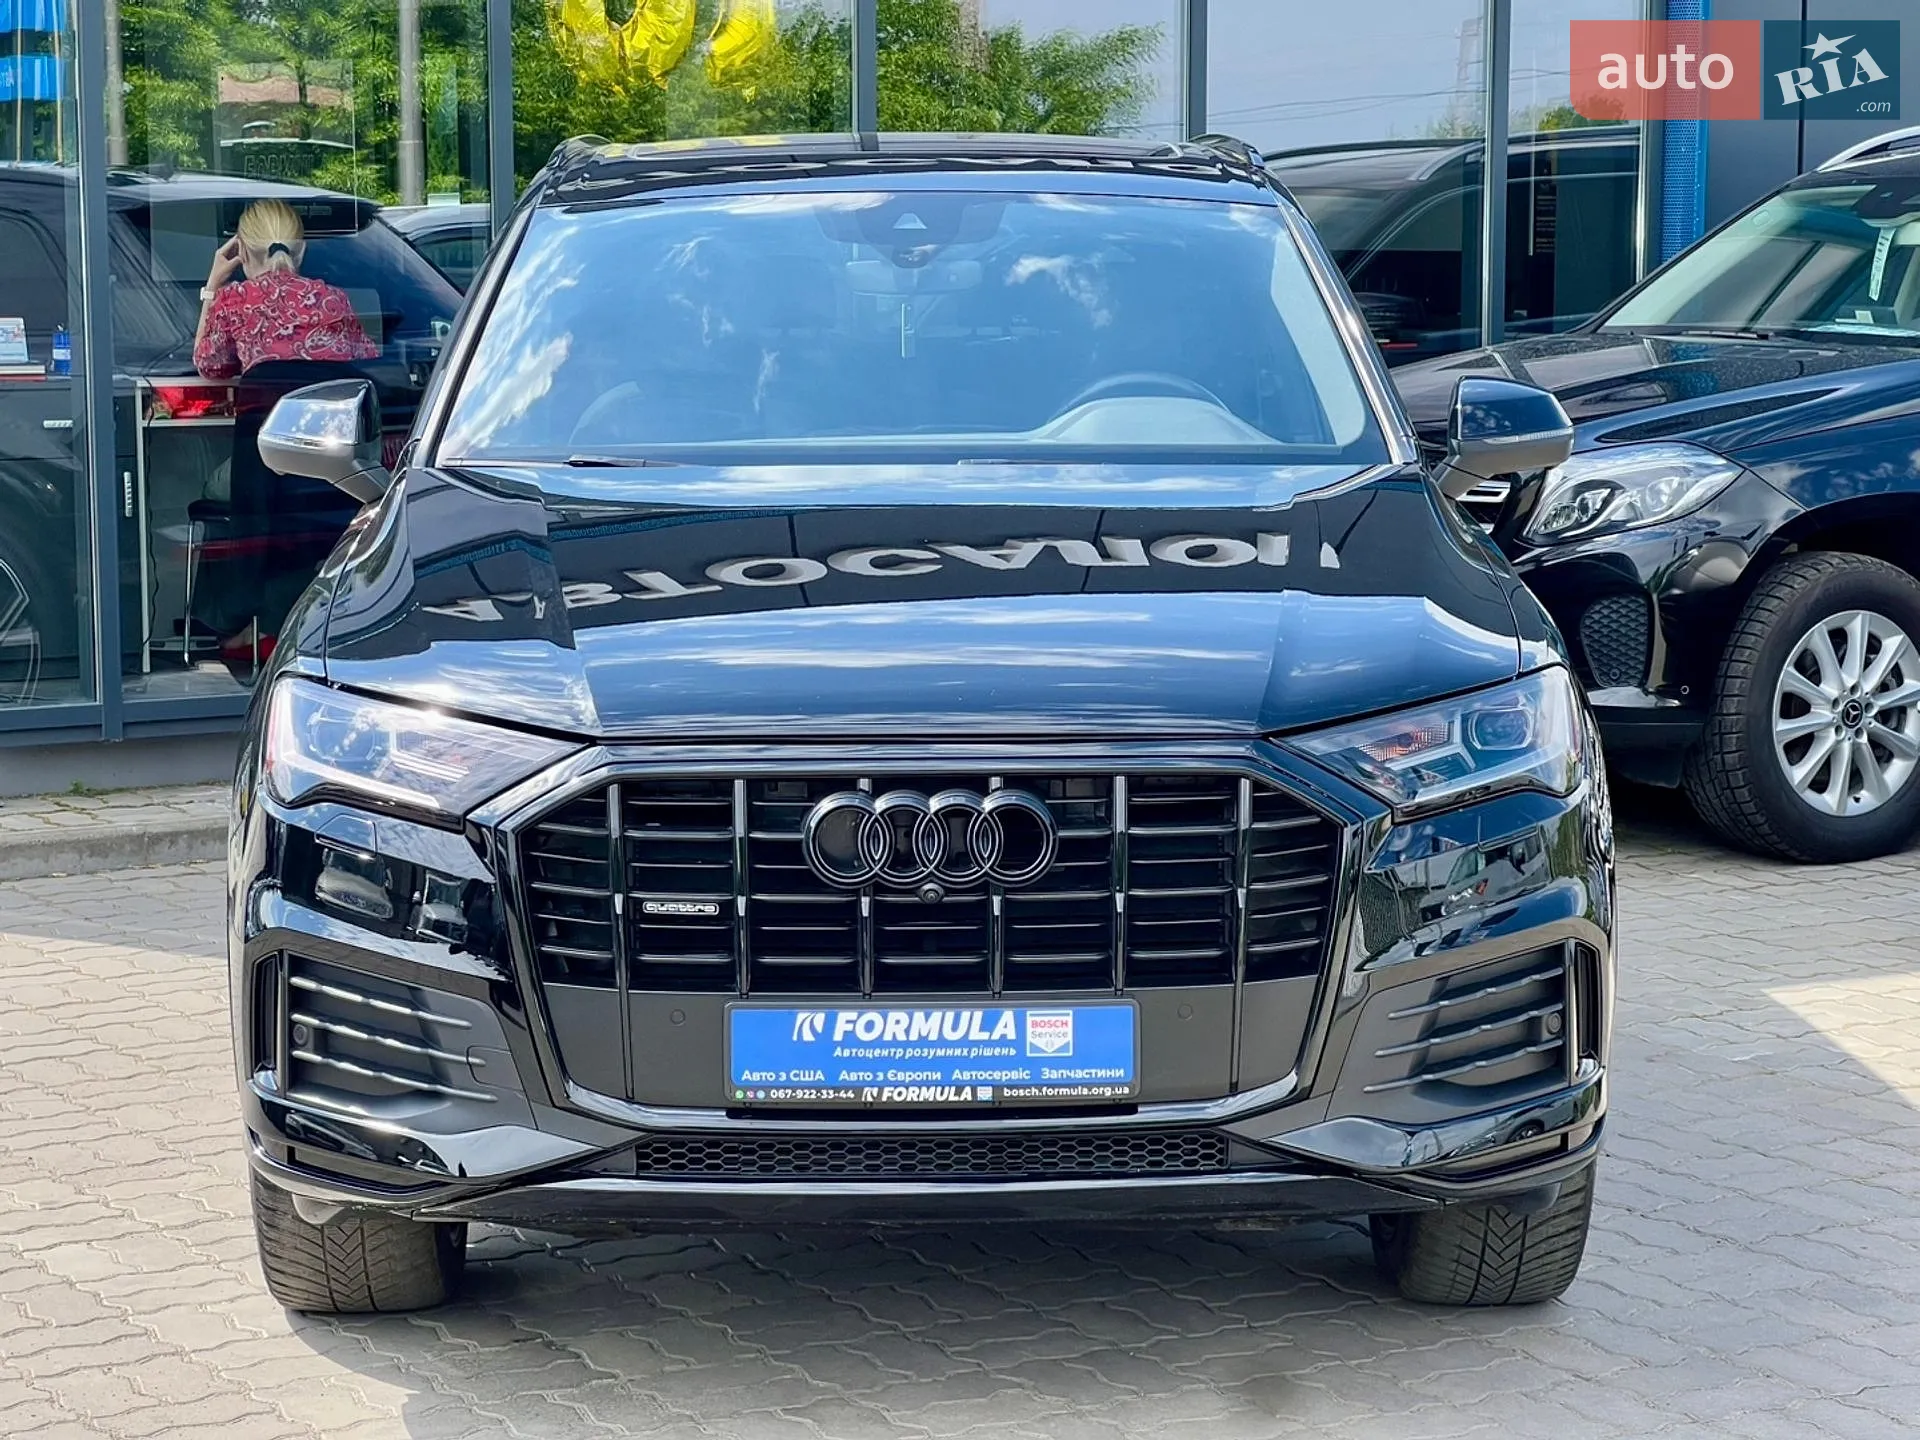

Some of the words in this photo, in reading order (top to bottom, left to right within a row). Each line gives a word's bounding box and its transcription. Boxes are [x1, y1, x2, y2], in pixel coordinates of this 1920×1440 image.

[646, 903, 716, 912] quattro
[833, 1010, 1017, 1041] FORMULA
[1031, 1020, 1069, 1028] BOSCH
[1031, 1030, 1069, 1039] Service
[833, 1047, 903, 1059] Автоцентр
[904, 1047, 968, 1059] розумних
[970, 1044, 1017, 1058] рішень
[741, 1069, 776, 1081] Авто
[789, 1070, 825, 1081] США
[838, 1069, 873, 1081] Авто
[886, 1069, 941, 1083] Європи
[951, 1067, 1031, 1082] Автосервіс
[1040, 1067, 1124, 1079] Запчастини
[770, 1089, 855, 1099] 067-922-33-44
[881, 1086, 972, 1101] FORMULA
[1003, 1085, 1130, 1097] bosch.formula.org.ua
